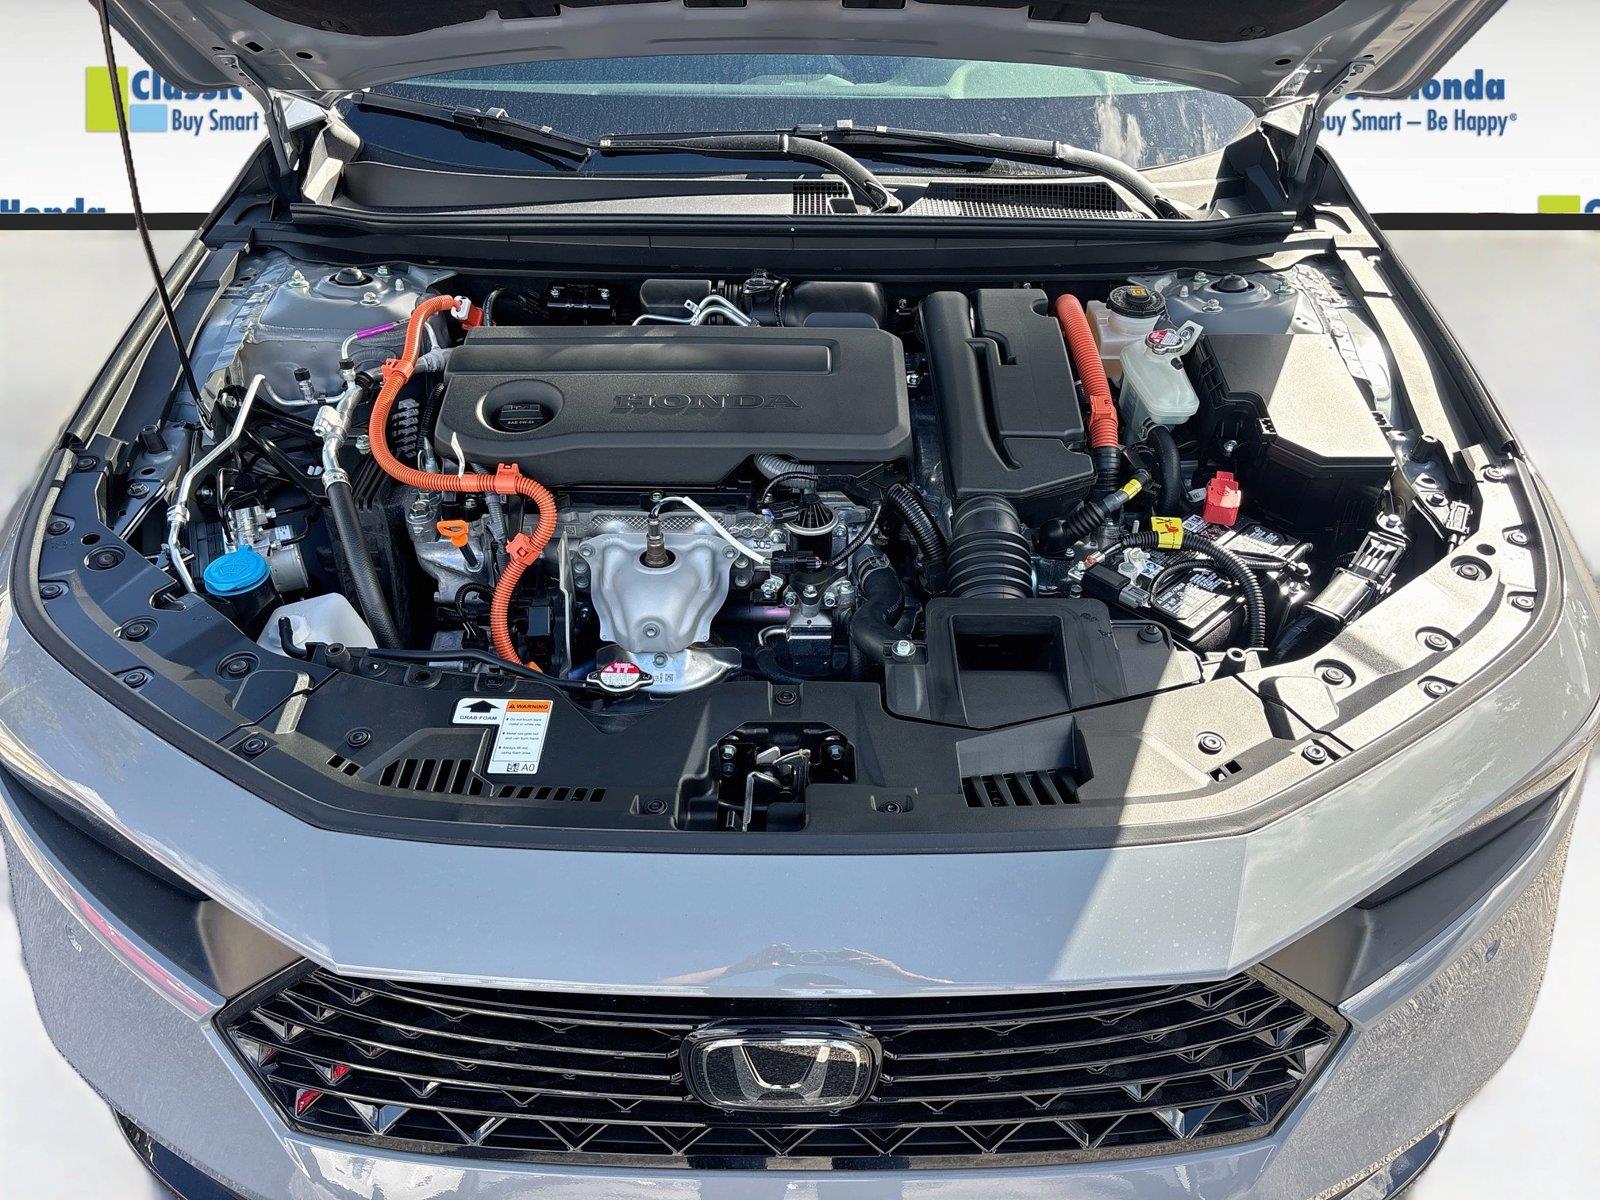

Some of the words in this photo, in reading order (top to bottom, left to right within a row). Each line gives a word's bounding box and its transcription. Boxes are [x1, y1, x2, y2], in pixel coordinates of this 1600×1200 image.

[1407, 68, 1505, 100] onda
[172, 108, 203, 136] Buy
[209, 108, 259, 131] Smart
[1352, 108, 1401, 131] Smart
[1427, 109, 1448, 131] Be
[611, 393, 803, 410] HONDA
